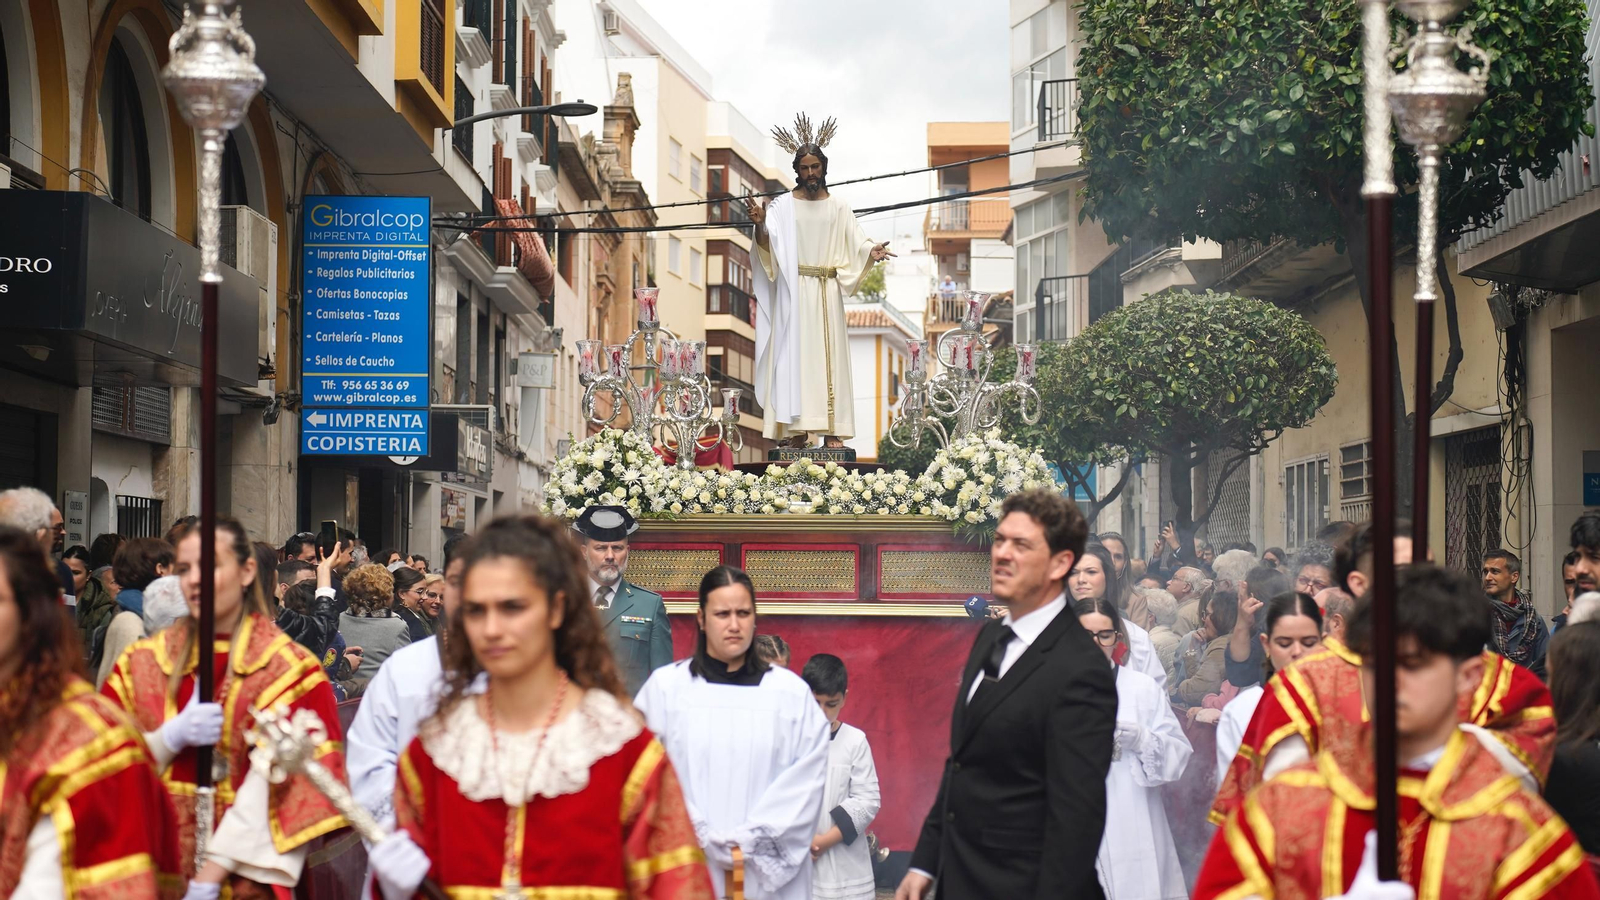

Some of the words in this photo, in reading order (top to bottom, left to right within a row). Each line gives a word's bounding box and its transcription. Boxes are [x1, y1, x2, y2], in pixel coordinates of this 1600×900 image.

[311, 204, 424, 231] Gibralcop
[309, 231, 371, 241] IMPRENTA
[375, 232, 424, 241] DIGITAL
[317, 249, 360, 261] Imprenta
[362, 249, 427, 262] Digital-Offset
[316, 267, 354, 280] Regalos
[356, 268, 415, 279] Publicitarios
[316, 287, 352, 299] Ofertas
[353, 288, 408, 302] Bonocopias
[316, 308, 365, 320] Camisetas
[374, 310, 400, 320] Tazas
[315, 331, 362, 342] Cartelería
[371, 332, 403, 343] Planos
[315, 355, 343, 366] Sellos
[345, 355, 358, 366] de
[359, 355, 395, 367] Caucho
[522, 363, 548, 377] P&P
[321, 380, 336, 390] Tlf:
[342, 380, 362, 390] 956
[364, 380, 378, 390] 65
[380, 380, 394, 390] 36
[396, 380, 410, 390] 69
[313, 392, 417, 404] www.gibralcop.es
[329, 413, 424, 428] IMPRENTA
[307, 436, 422, 452] COPISTERIA
